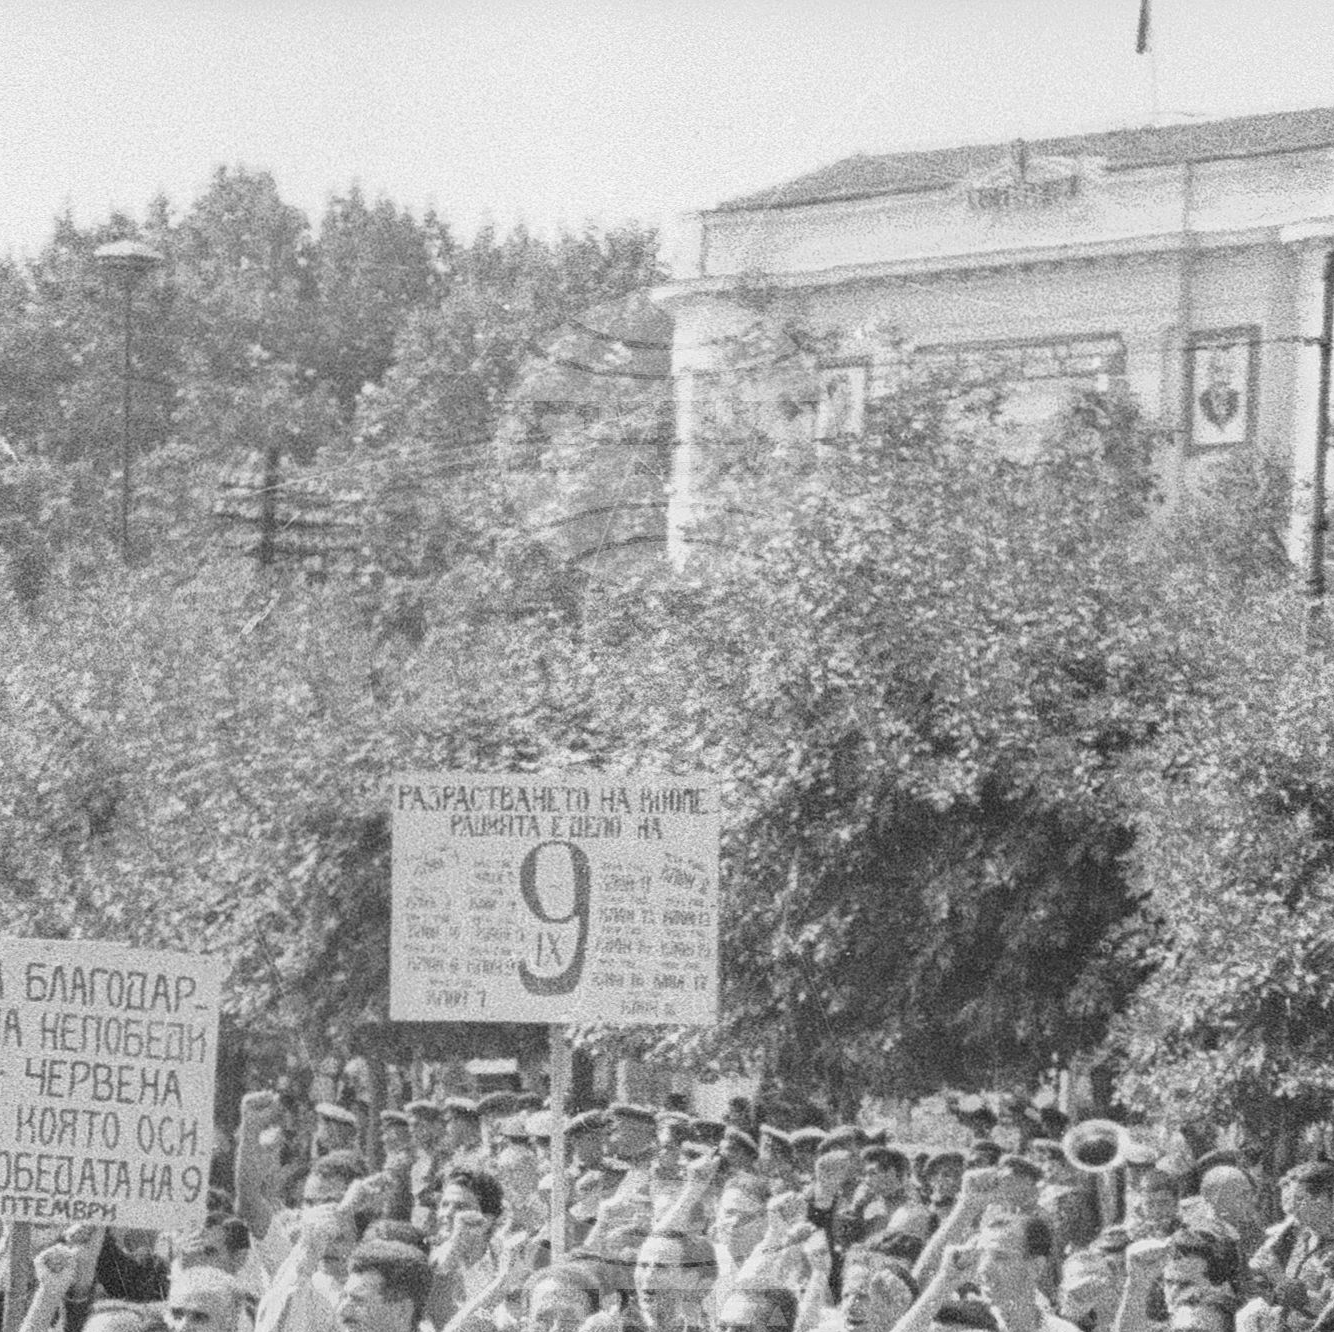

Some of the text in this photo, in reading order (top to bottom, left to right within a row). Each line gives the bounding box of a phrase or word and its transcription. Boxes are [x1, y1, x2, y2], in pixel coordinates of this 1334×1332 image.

[519, 839, 592, 997] 9
[25, 1056, 184, 1108] ЧЕРВЕНА
[16, 1105, 119, 1150] КОЯТО
[139, 1161, 174, 1201] НА
[180, 1164, 204, 1203] 9
